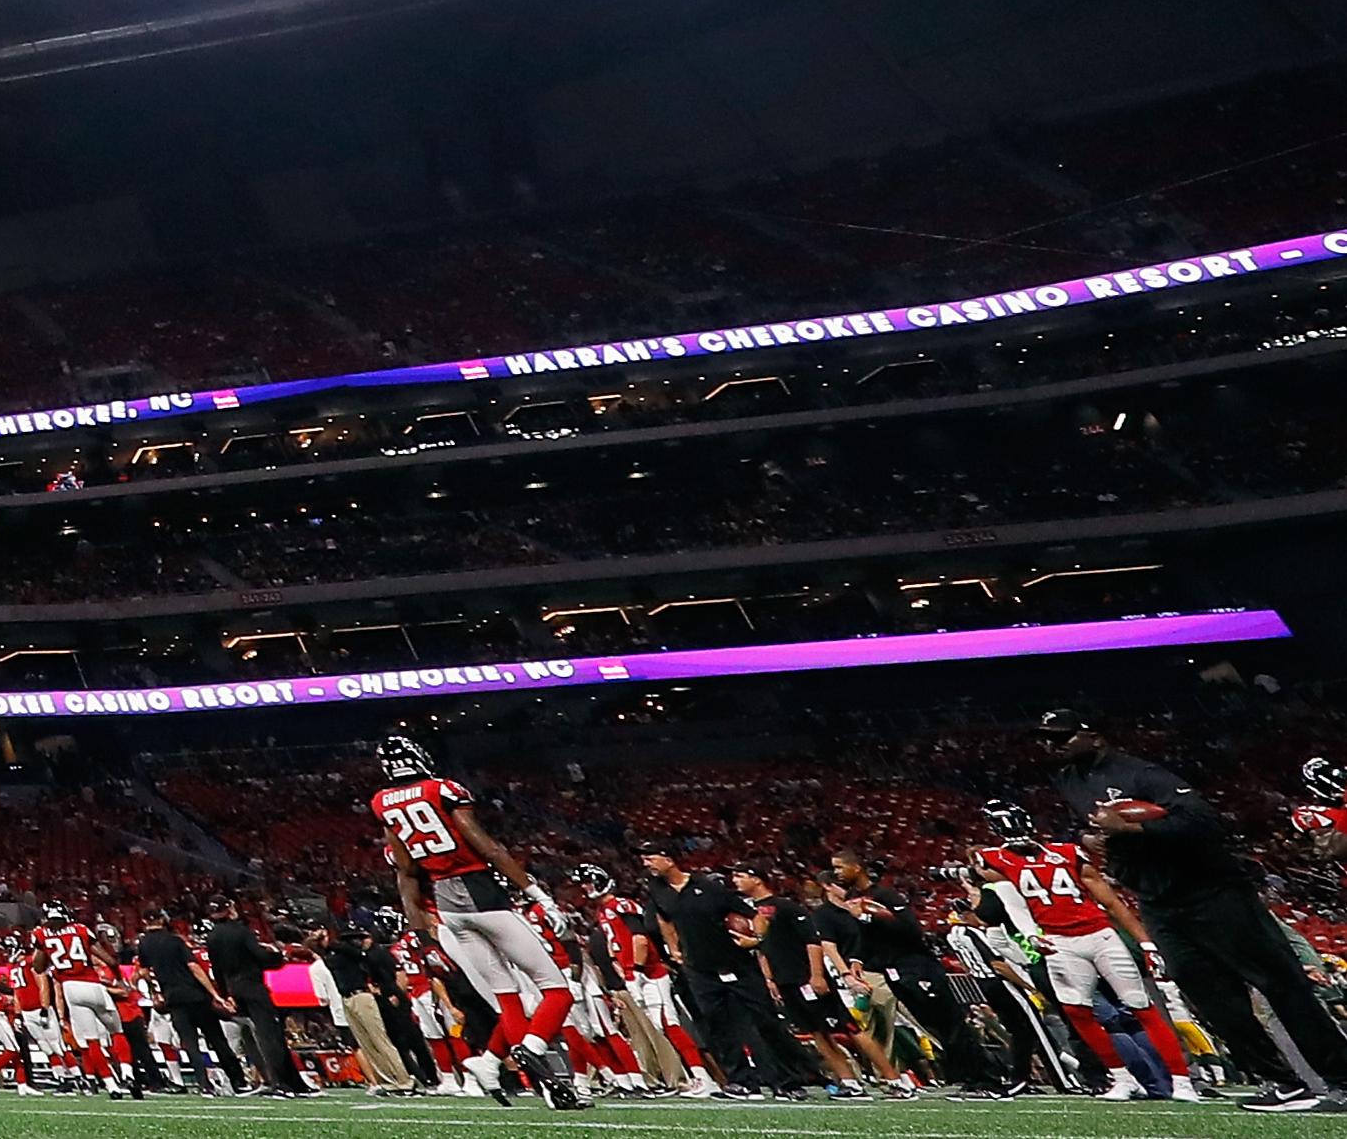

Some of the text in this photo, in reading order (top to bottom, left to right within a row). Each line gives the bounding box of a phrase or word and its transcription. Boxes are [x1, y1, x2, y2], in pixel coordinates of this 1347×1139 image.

[504, 338, 686, 375] HARRAH'S
[698, 312, 895, 352] CHEROKEE
[907, 286, 1069, 327] CASINO
[1084, 250, 1258, 300] RESORT
[149, 392, 193, 411] NC
[64, 691, 170, 712] CASINO
[180, 682, 294, 708] RESORT
[337, 665, 515, 698] CHEROKEE,
[521, 659, 574, 680] NC
[382, 801, 457, 860] 29
[1017, 867, 1084, 906] 44
[45, 936, 88, 969] 24
[10, 967, 26, 989] 51
